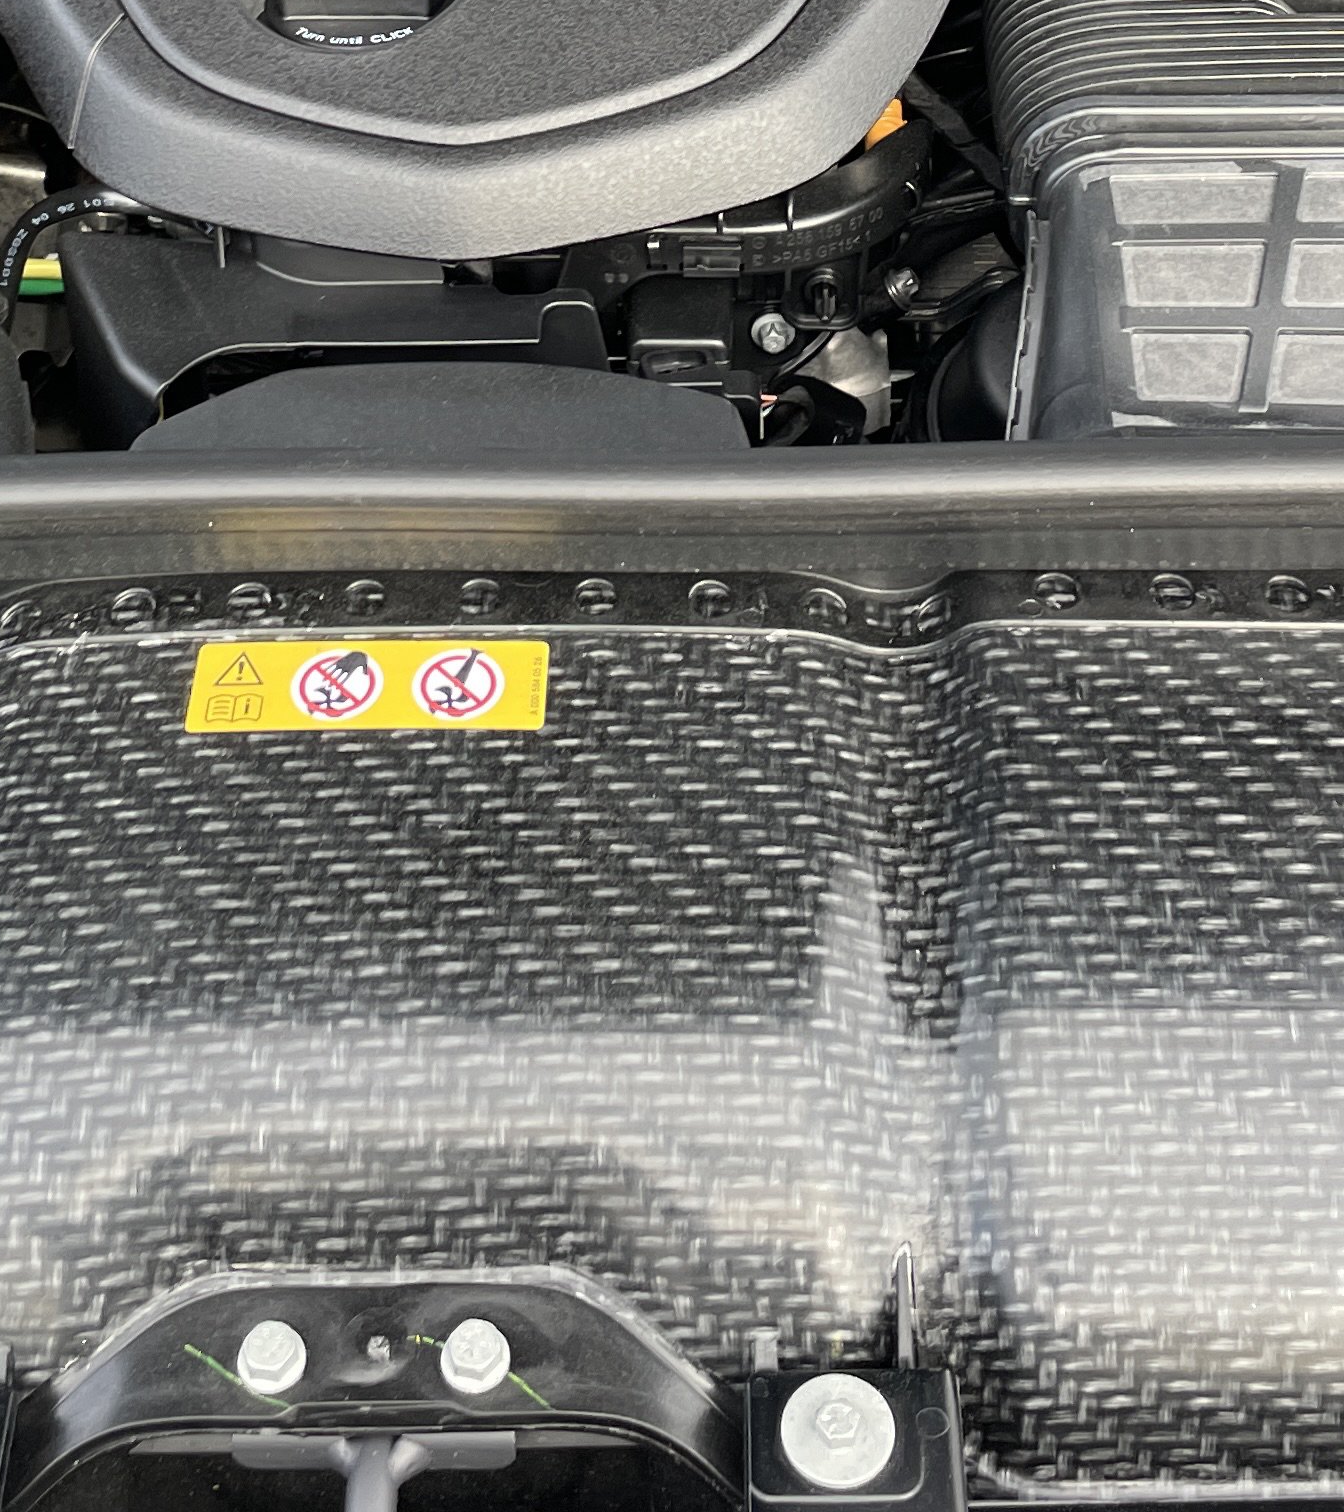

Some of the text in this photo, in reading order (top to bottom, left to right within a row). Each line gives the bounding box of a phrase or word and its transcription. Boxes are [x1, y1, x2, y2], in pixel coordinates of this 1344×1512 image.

[295, 26, 414, 45] Turn until CLICK
